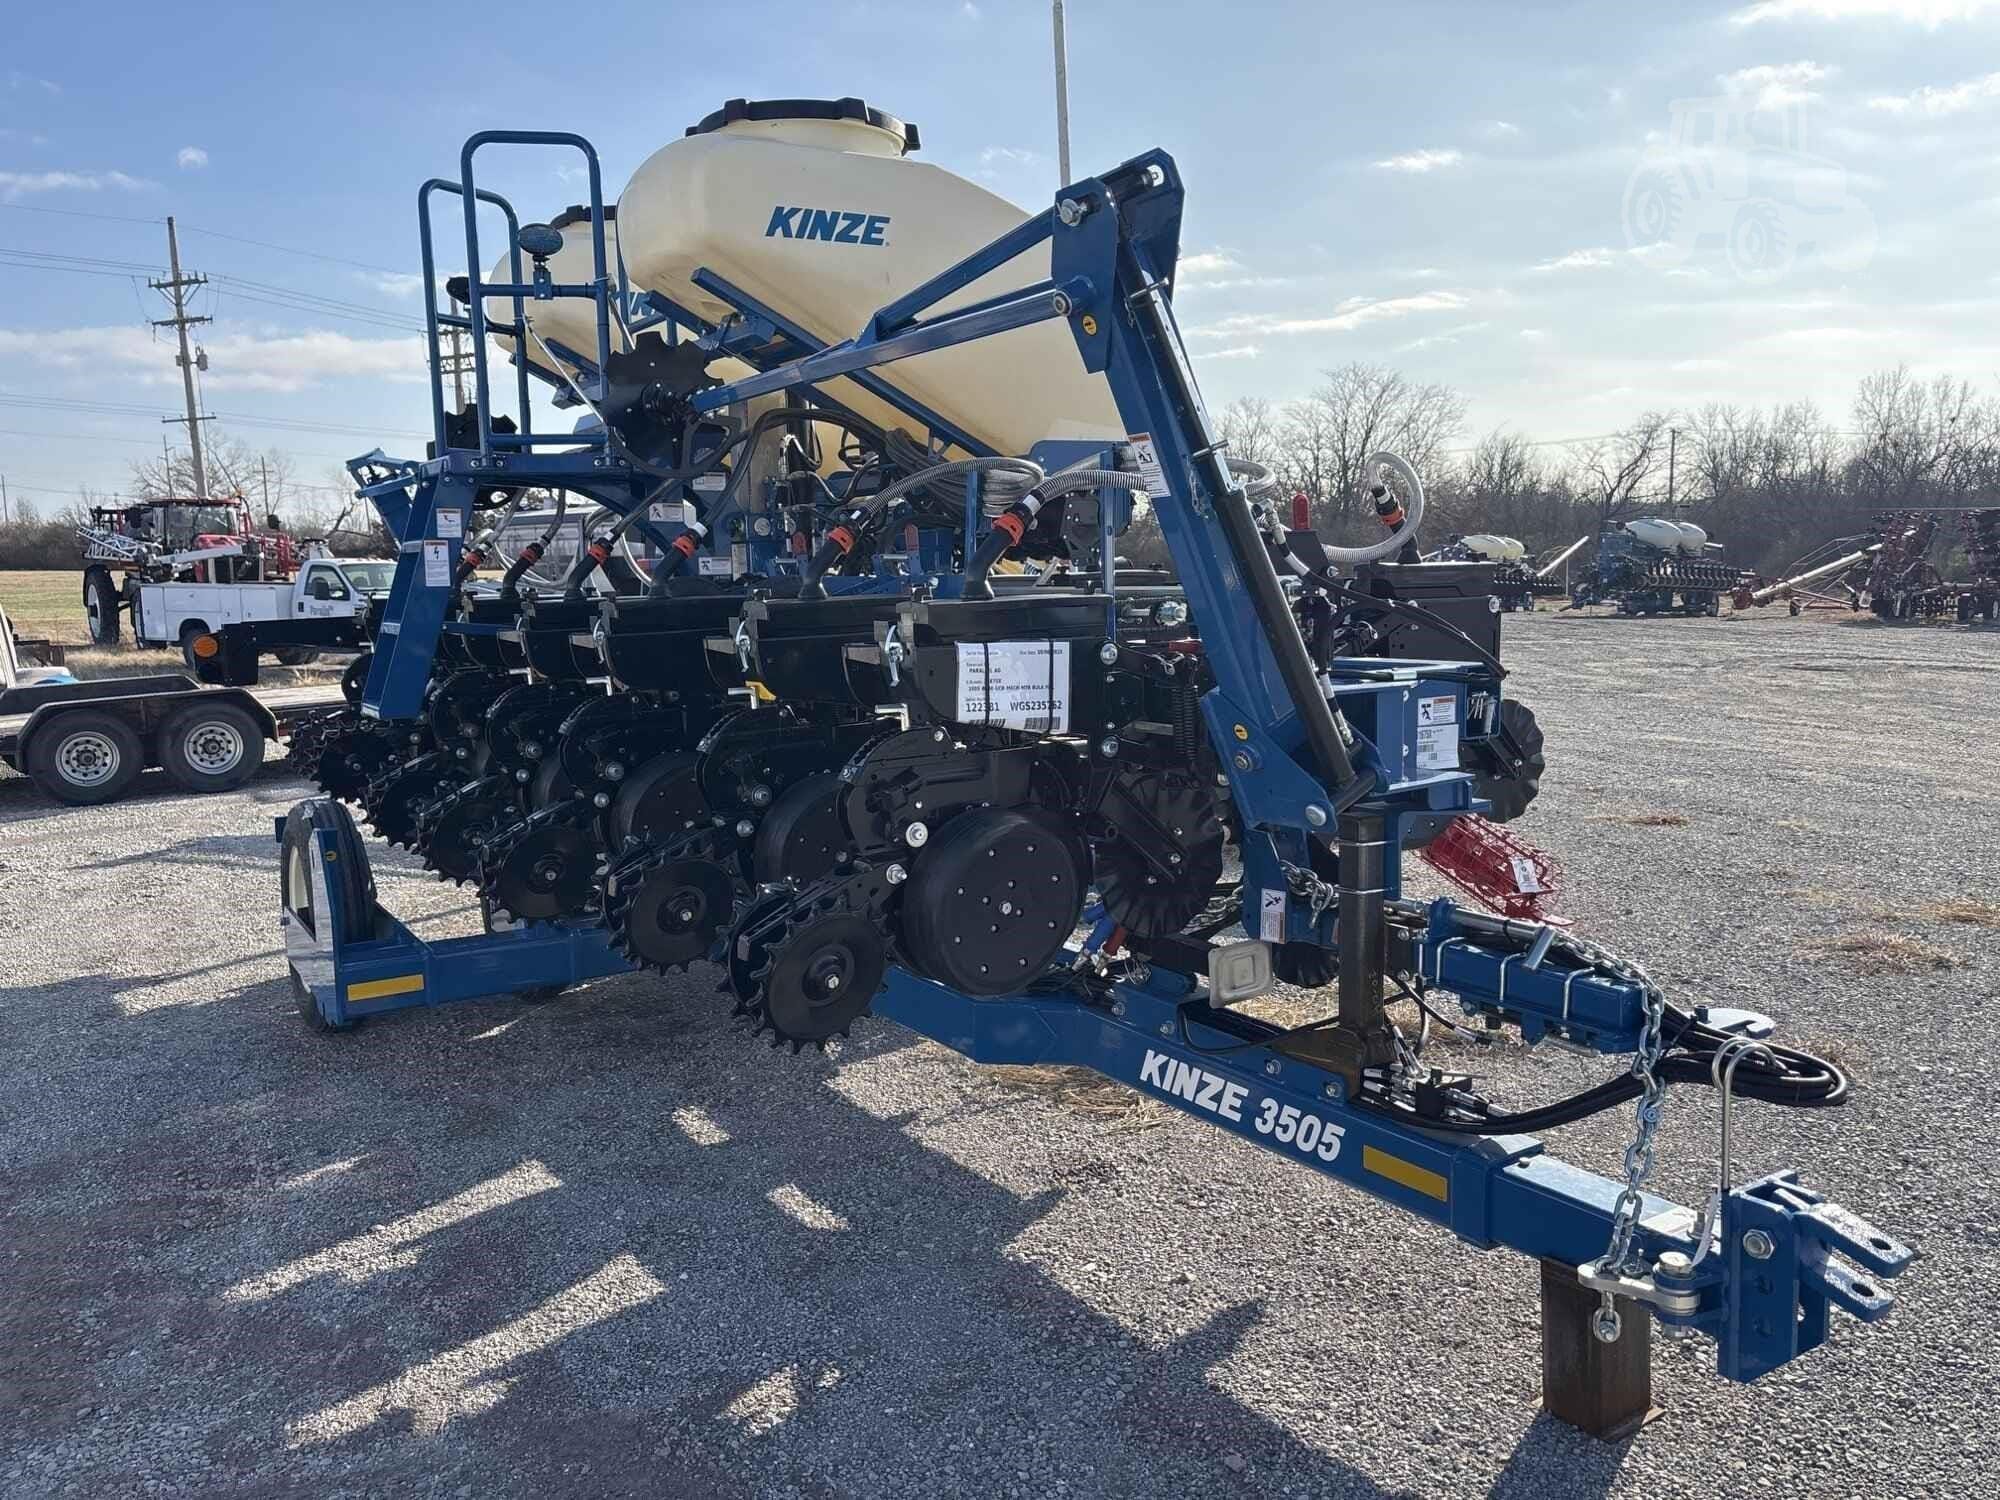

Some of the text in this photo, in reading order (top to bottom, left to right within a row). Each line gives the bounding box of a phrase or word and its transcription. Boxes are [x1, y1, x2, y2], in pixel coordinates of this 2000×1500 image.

[765, 206, 891, 246] KINZE
[1139, 1049, 1346, 1162] KINZE 3505
